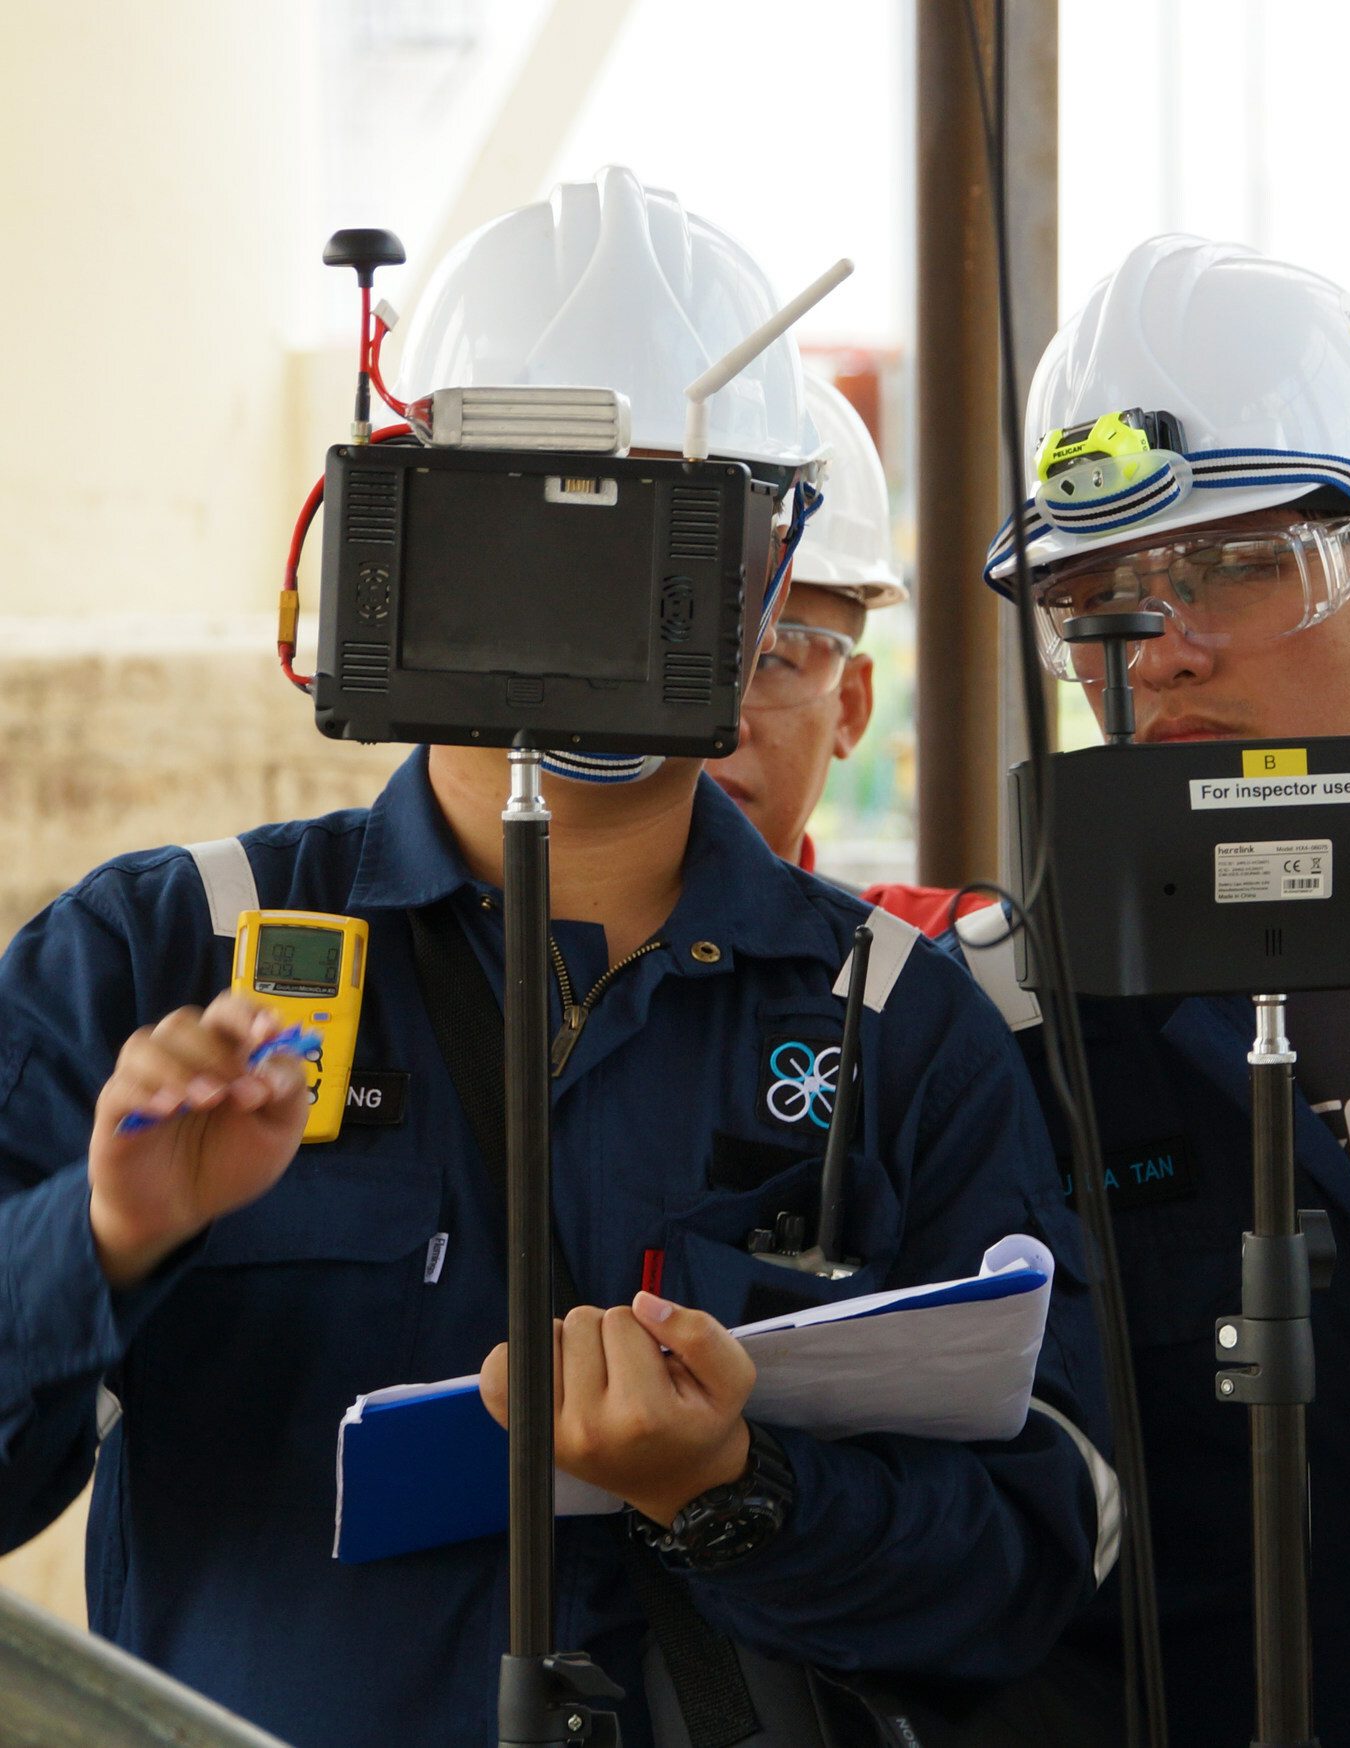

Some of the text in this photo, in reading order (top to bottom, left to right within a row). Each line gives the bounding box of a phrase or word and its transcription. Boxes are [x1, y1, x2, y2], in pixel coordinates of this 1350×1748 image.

[1053, 446, 1083, 459] PELICAN
[1264, 755, 1276, 769] B
[1201, 785, 1230, 800] For
[1236, 782, 1317, 800] inspector
[1129, 1155, 1174, 1184] TAN
